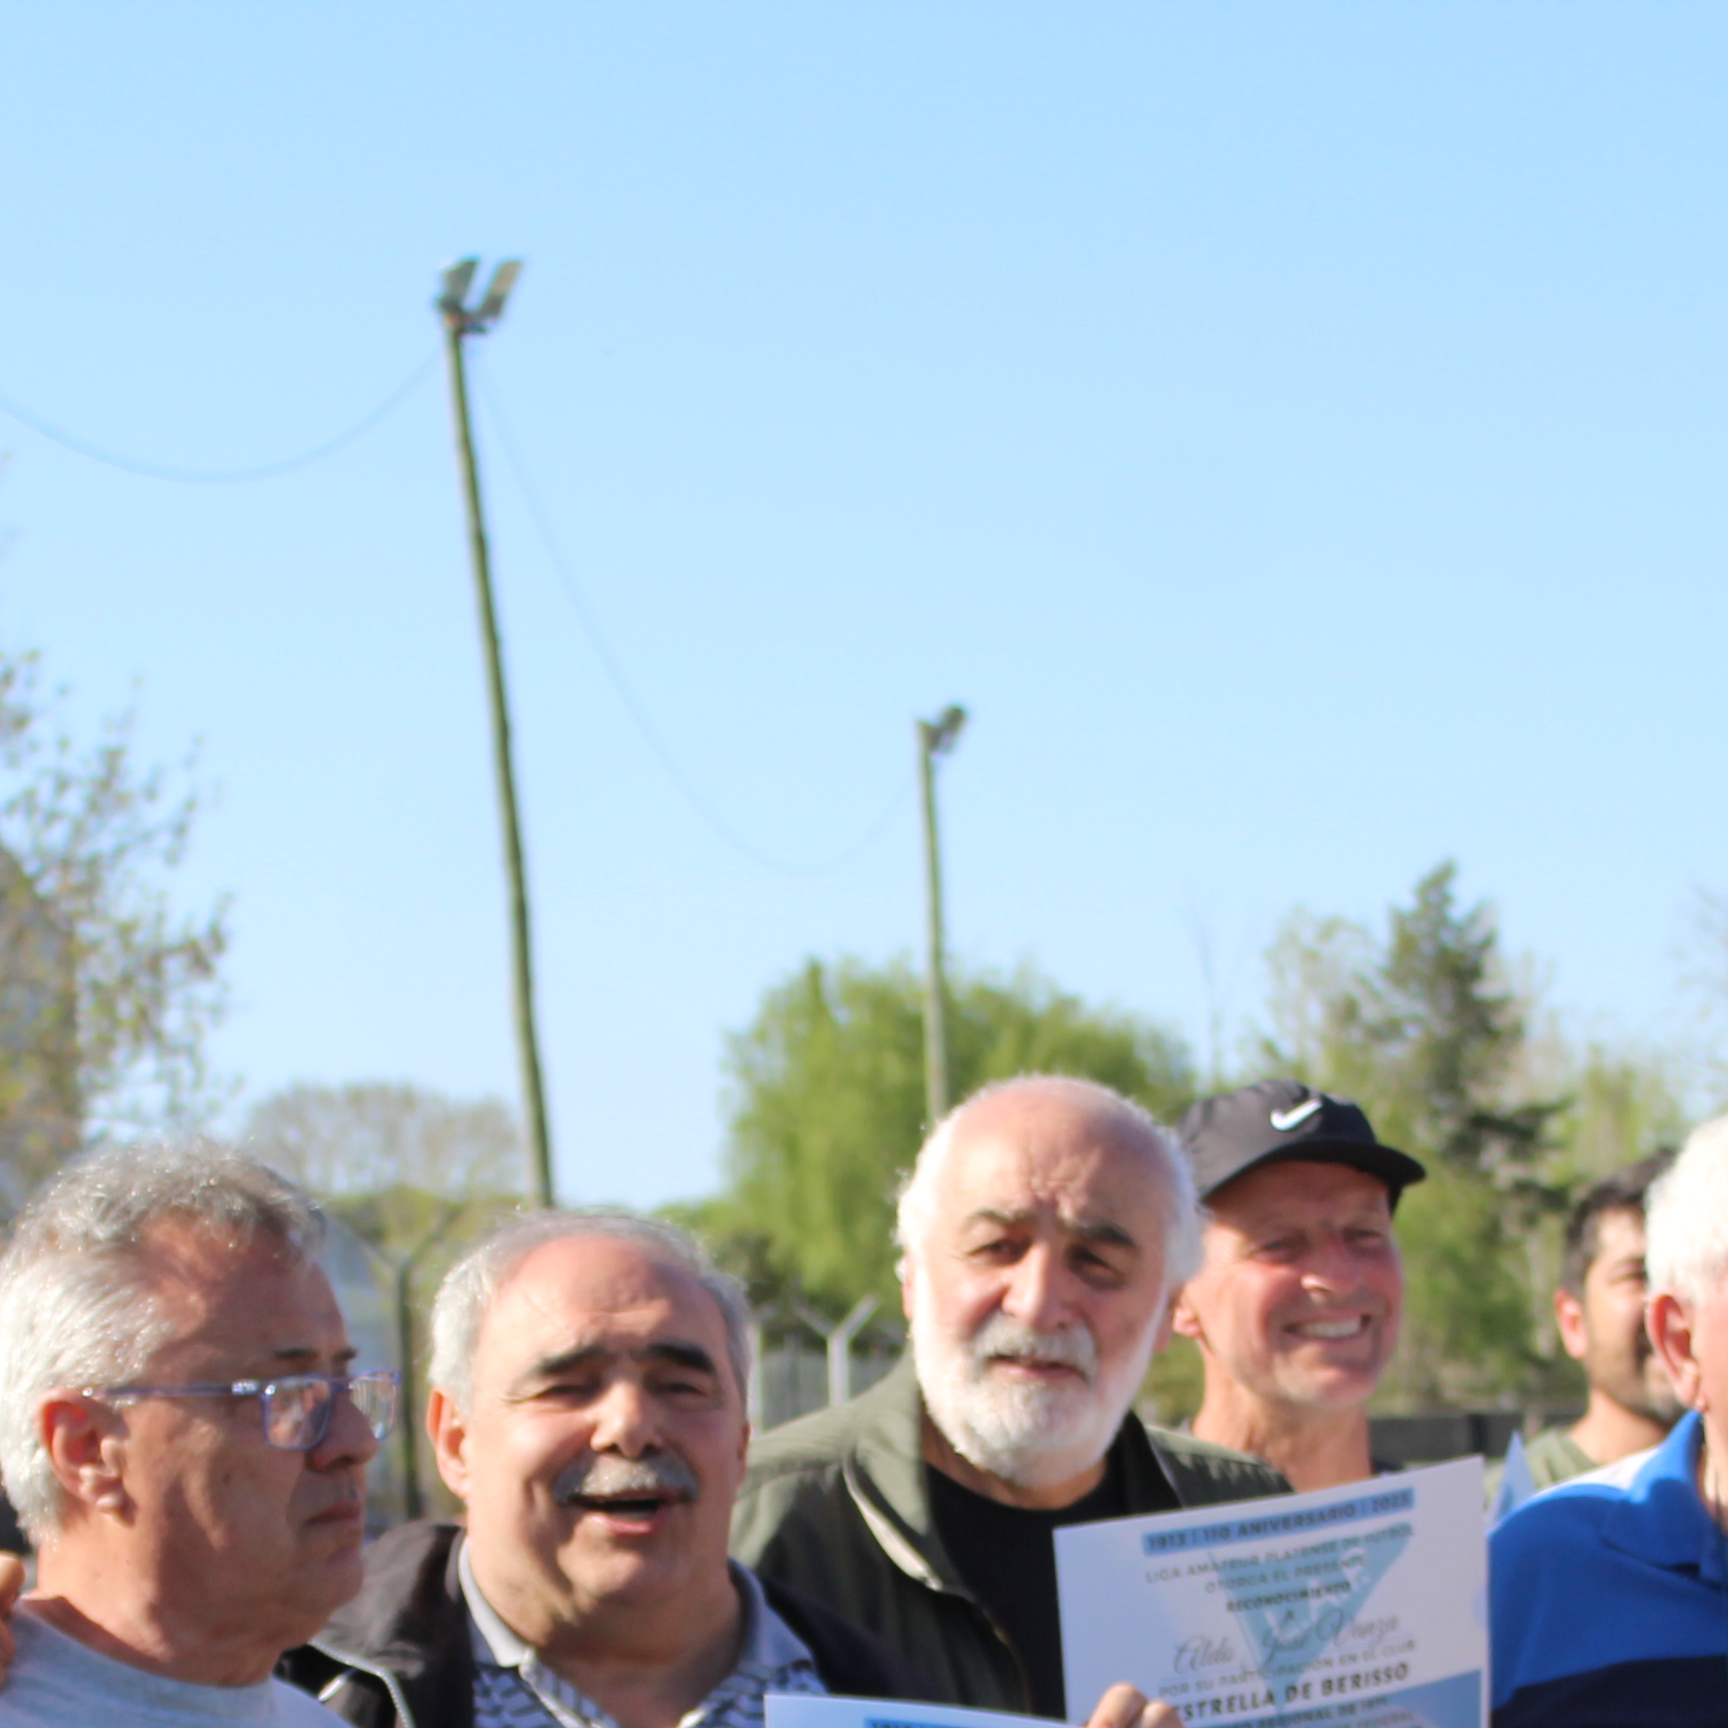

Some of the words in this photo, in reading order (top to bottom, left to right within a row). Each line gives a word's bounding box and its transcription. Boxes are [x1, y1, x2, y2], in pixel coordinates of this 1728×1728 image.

[1173, 1685, 1276, 1723] STRELLA
[1285, 1681, 1312, 1703] DE
[1320, 1661, 1410, 1696] BERISSO
